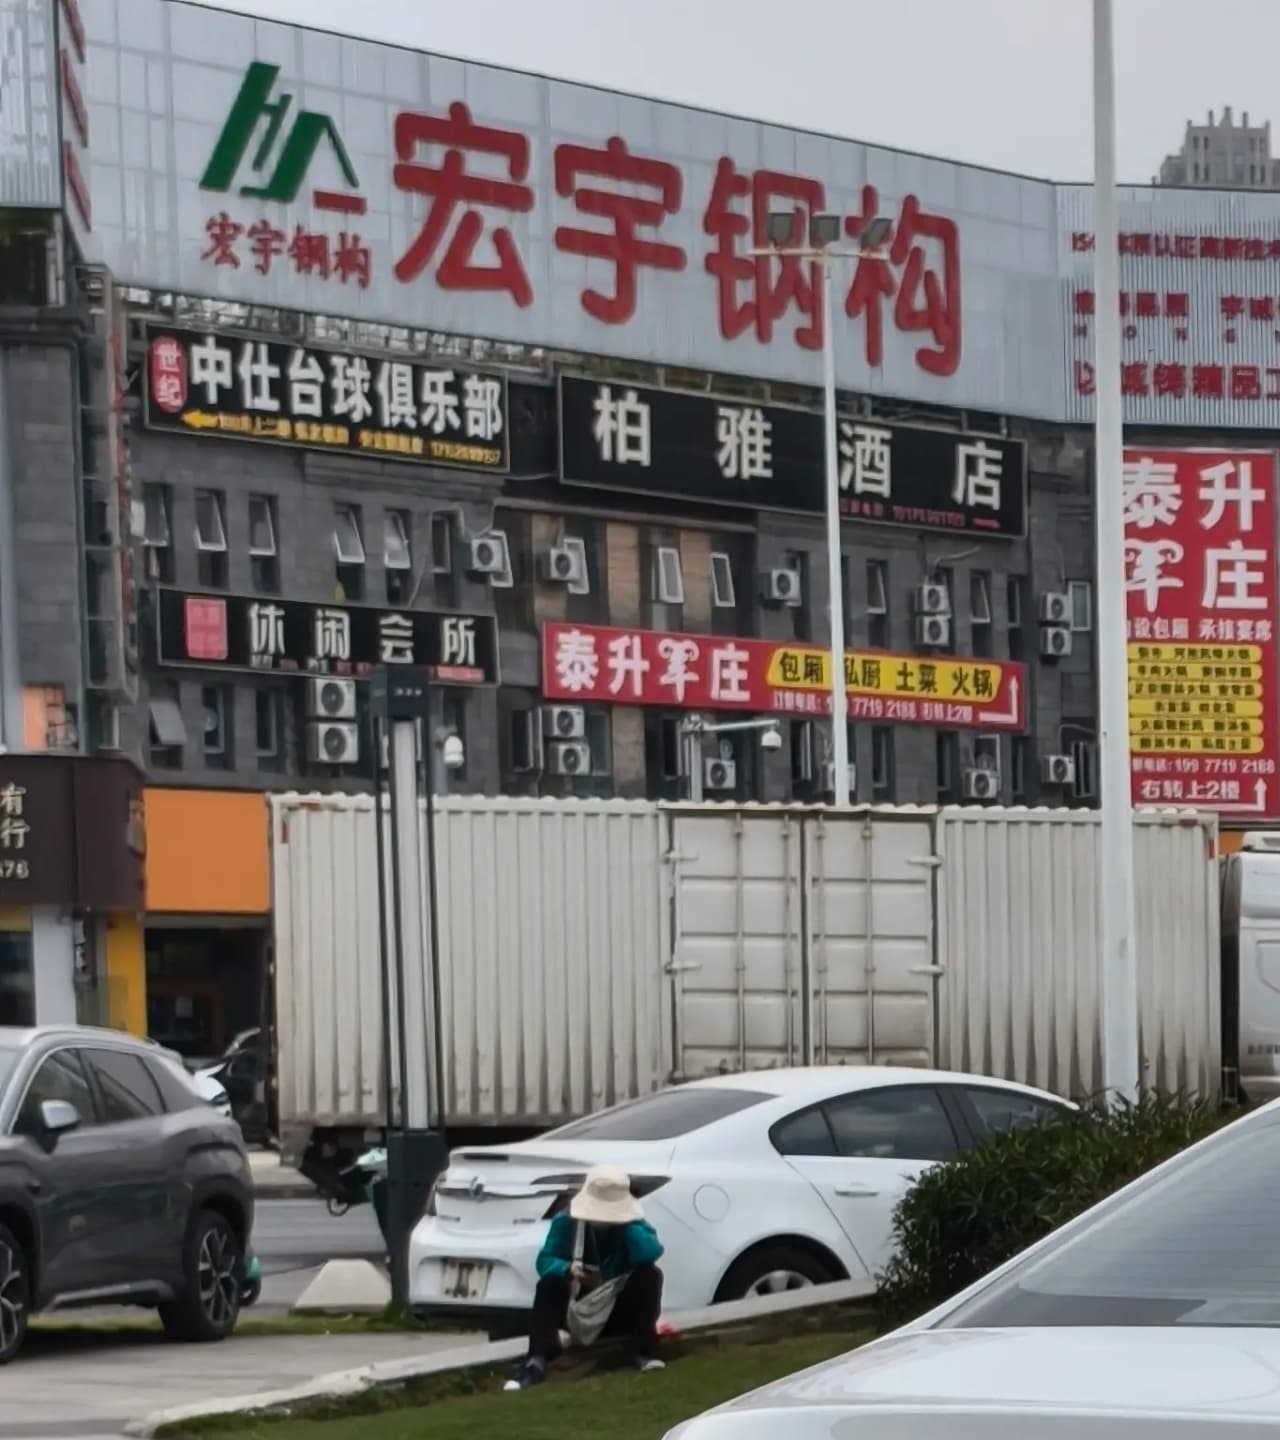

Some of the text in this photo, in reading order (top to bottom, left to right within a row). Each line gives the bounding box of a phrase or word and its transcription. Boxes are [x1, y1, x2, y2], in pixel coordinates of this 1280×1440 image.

[200, 211, 372, 288] 宏宇钢构
[393, 101, 961, 378] 宏宇钢构
[154, 342, 182, 404] 世纪
[190, 335, 503, 441] 中仕台球俱乐部
[594, 388, 1003, 511] 柏雅酒店
[249, 602, 477, 665] 休闲会所
[895, 662, 938, 694] 土菜
[952, 666, 993, 698] 火锅
